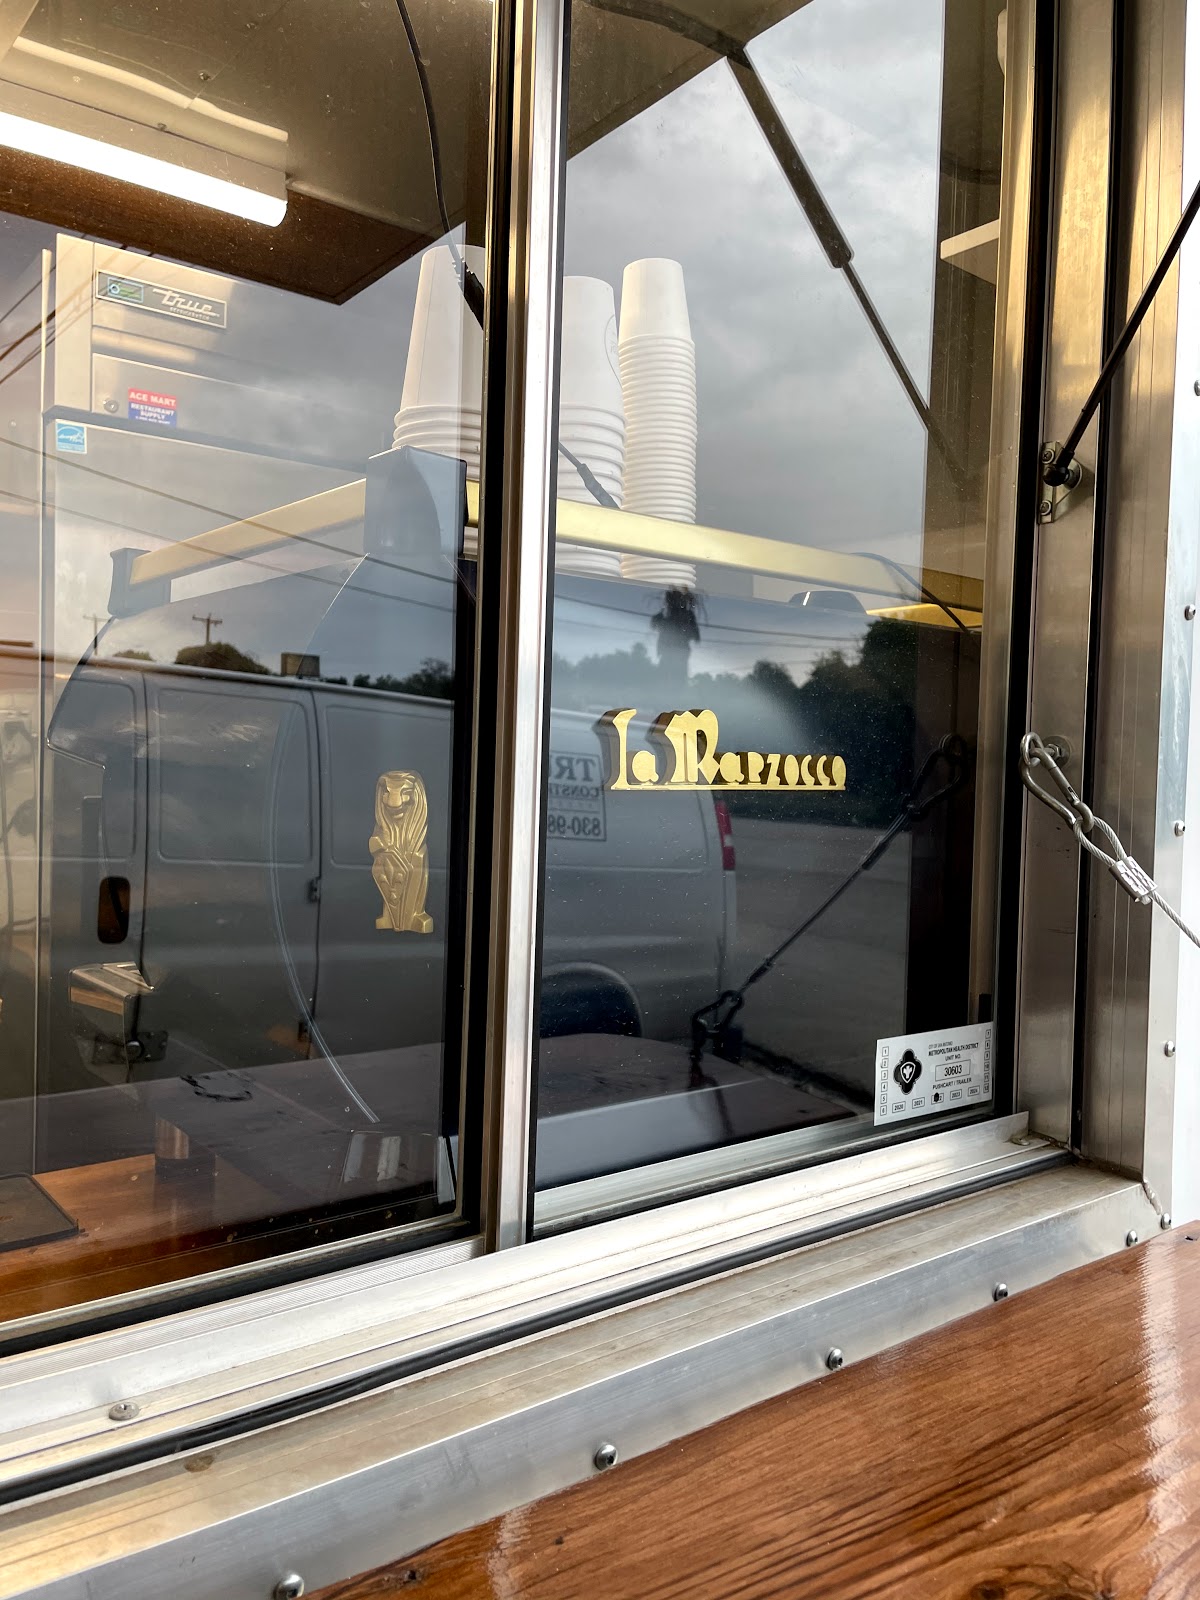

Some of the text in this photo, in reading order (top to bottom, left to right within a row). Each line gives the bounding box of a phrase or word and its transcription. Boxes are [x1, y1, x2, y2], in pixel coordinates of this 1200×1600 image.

[129, 391, 176, 407] ACE MART
[130, 402, 175, 417] RESTAURANT
[140, 411, 166, 421] SUPPLY
[610, 708, 847, 790] La Marzocco
[928, 1047, 953, 1056] METROPOLITAN
[965, 1042, 979, 1050] DISTRICT
[944, 1065, 962, 1077] 30603
[932, 1081, 953, 1090] PUSHCART
[956, 1077, 972, 1086] TRAILER
